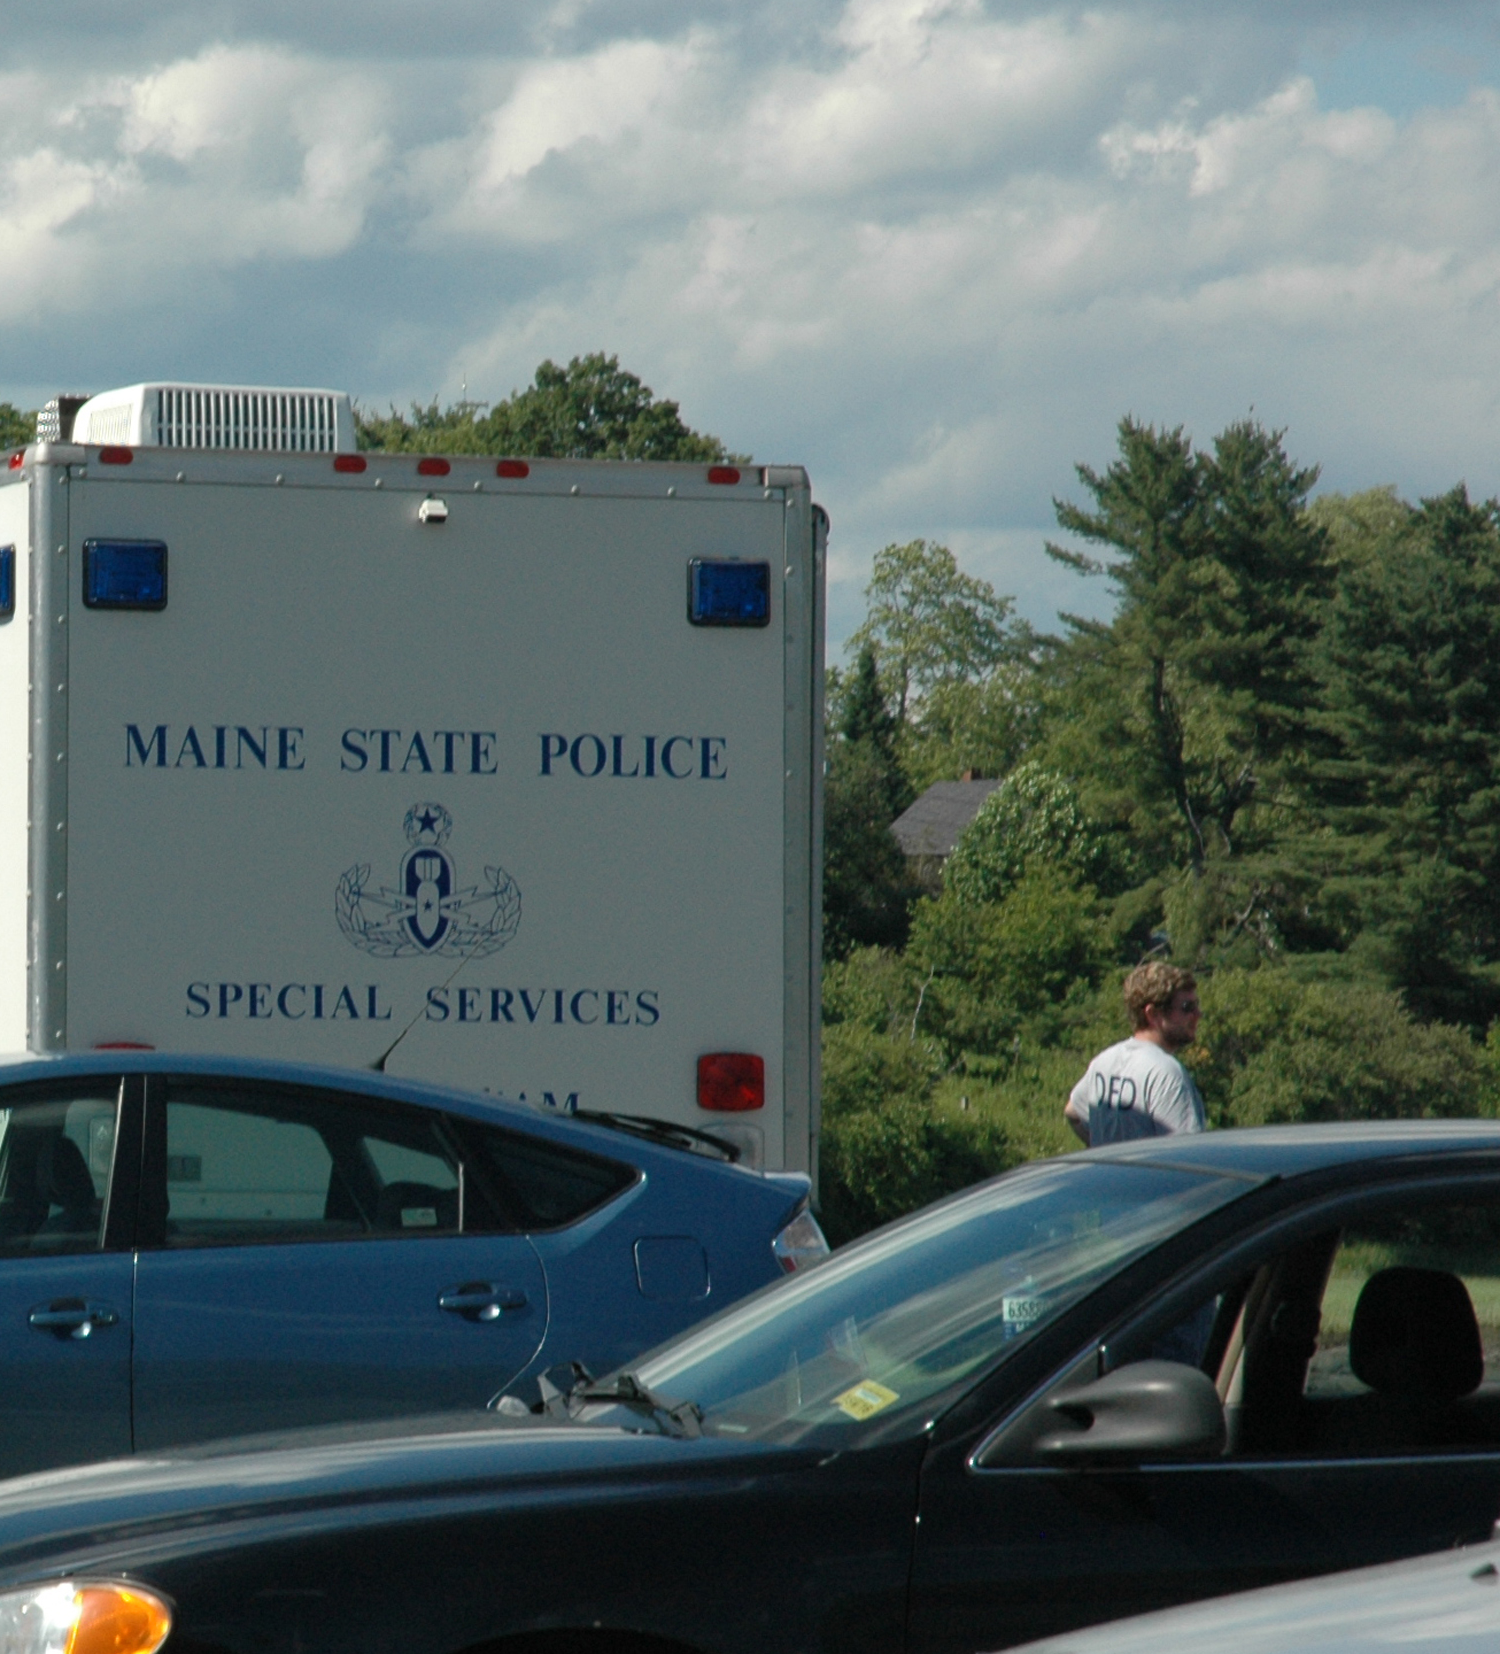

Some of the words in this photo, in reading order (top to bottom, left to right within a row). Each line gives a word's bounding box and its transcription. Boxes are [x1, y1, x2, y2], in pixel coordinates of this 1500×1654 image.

[124, 723, 306, 771] MAINE
[340, 728, 499, 775] STATE
[539, 733, 728, 780] POLICE
[185, 982, 392, 1020] SPECIAL
[425, 987, 660, 1026] SERVICES
[1095, 1068, 1137, 1112] DFD
